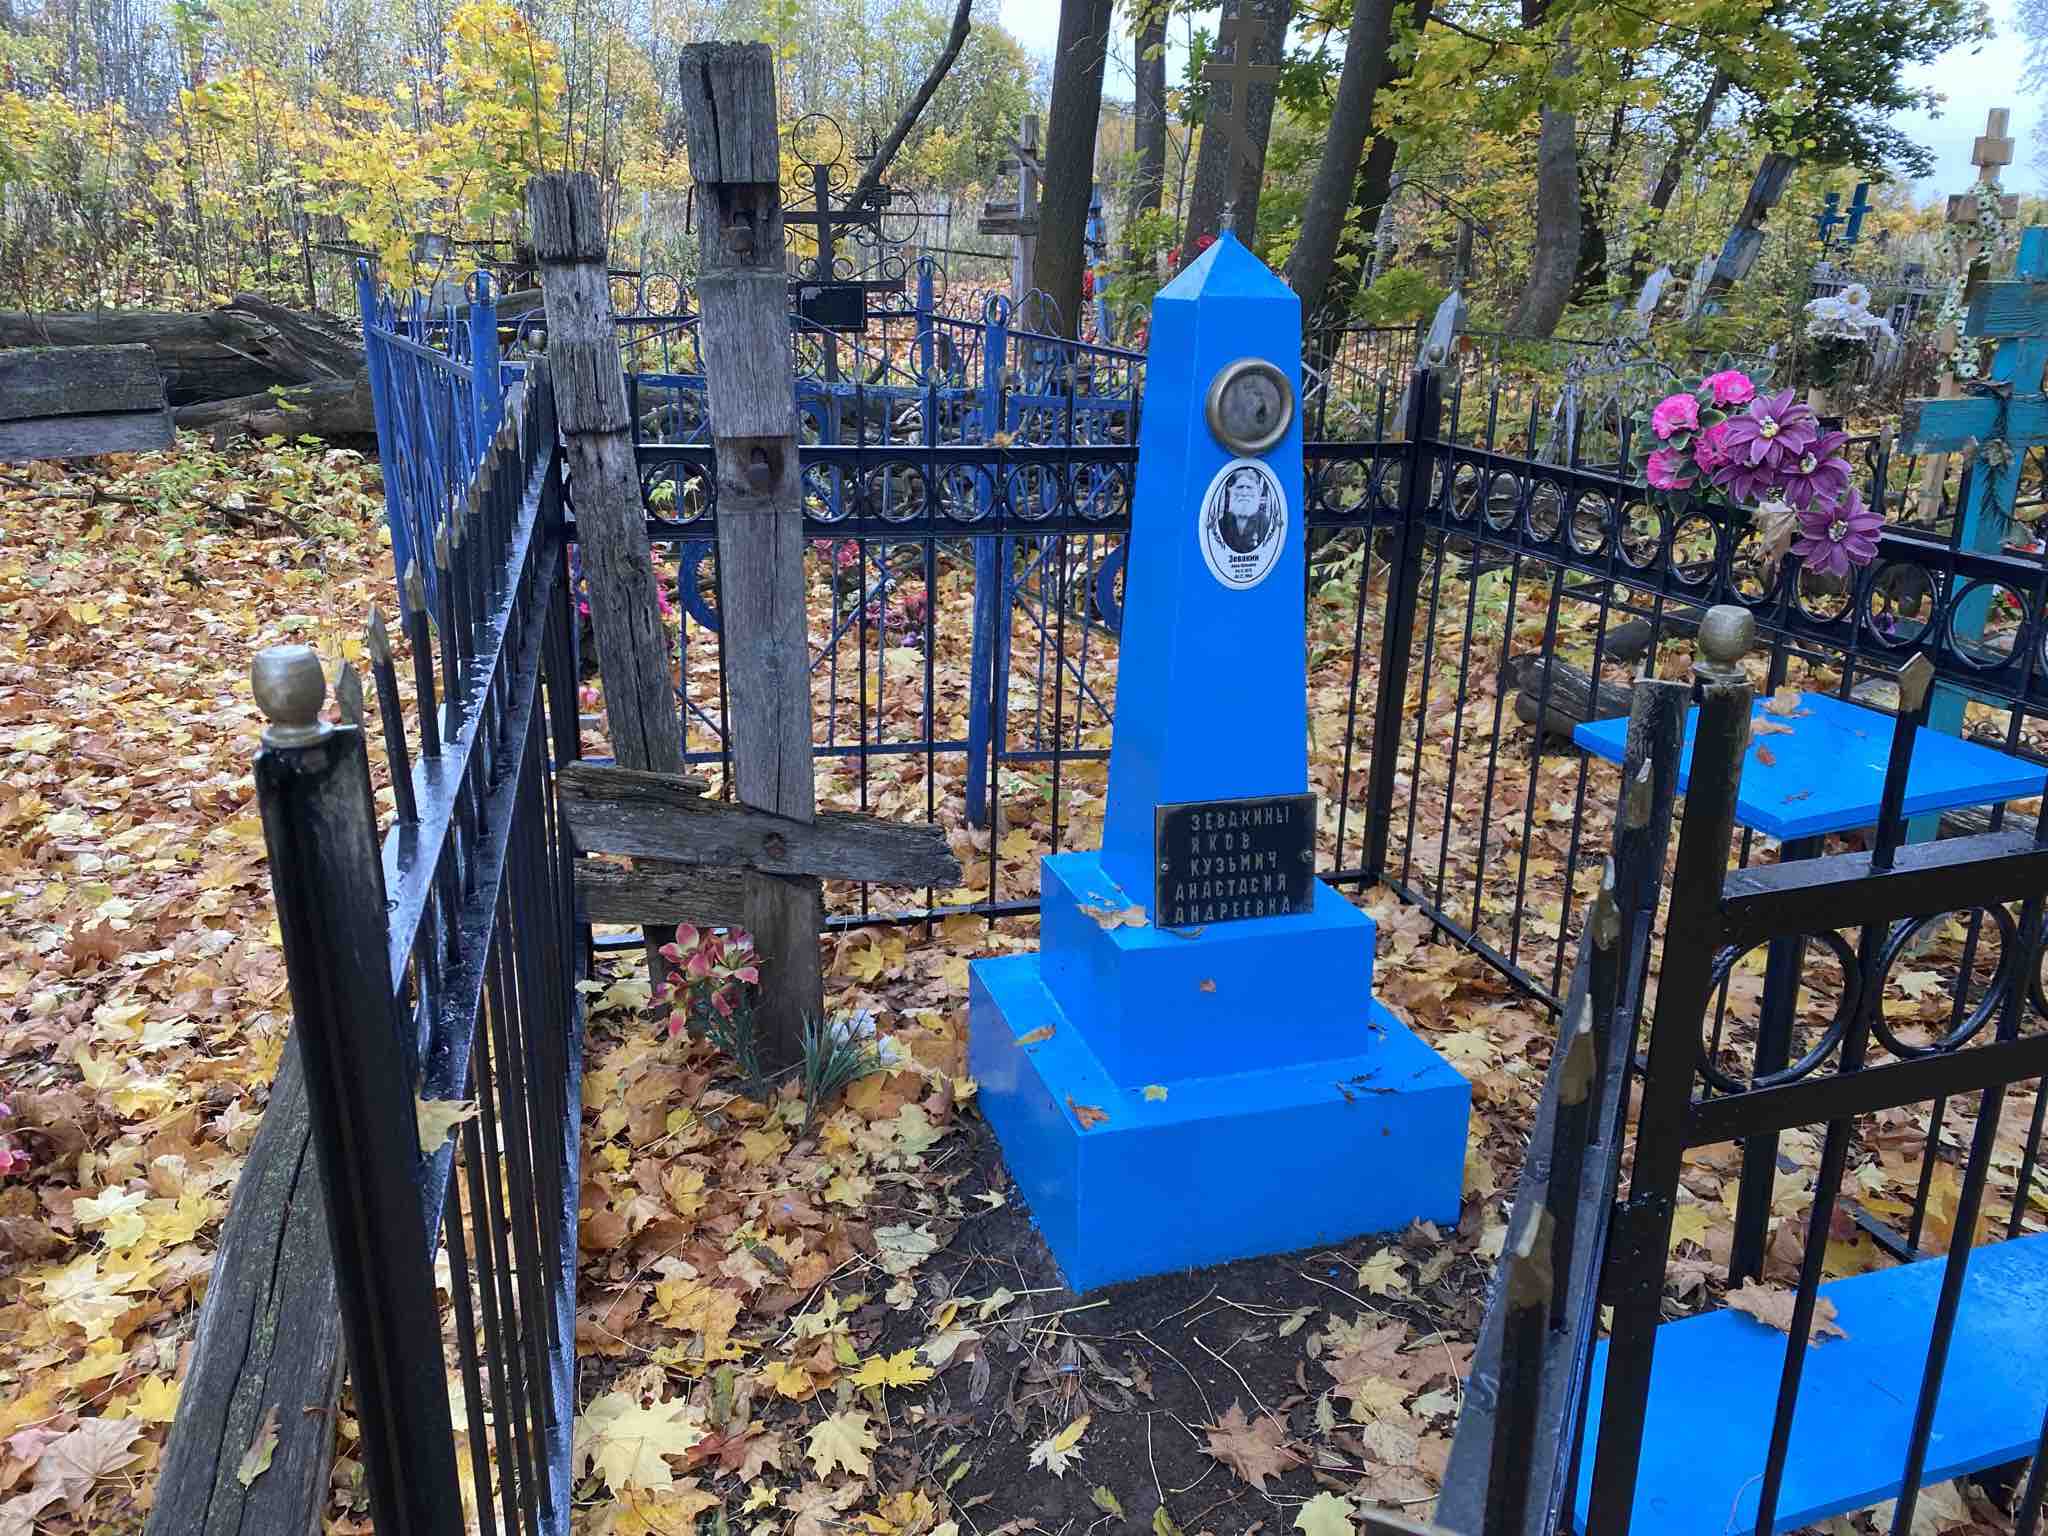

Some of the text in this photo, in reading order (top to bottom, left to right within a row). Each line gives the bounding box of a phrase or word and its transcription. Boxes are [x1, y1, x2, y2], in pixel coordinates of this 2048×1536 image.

[1191, 832, 1251, 854] ЯКОВ
[1191, 851, 1278, 876] КУЗЬМИЧ
[1175, 873, 1288, 901] АНАСТАСИЯ
[1175, 896, 1290, 923] АНДРЕЕВНА
